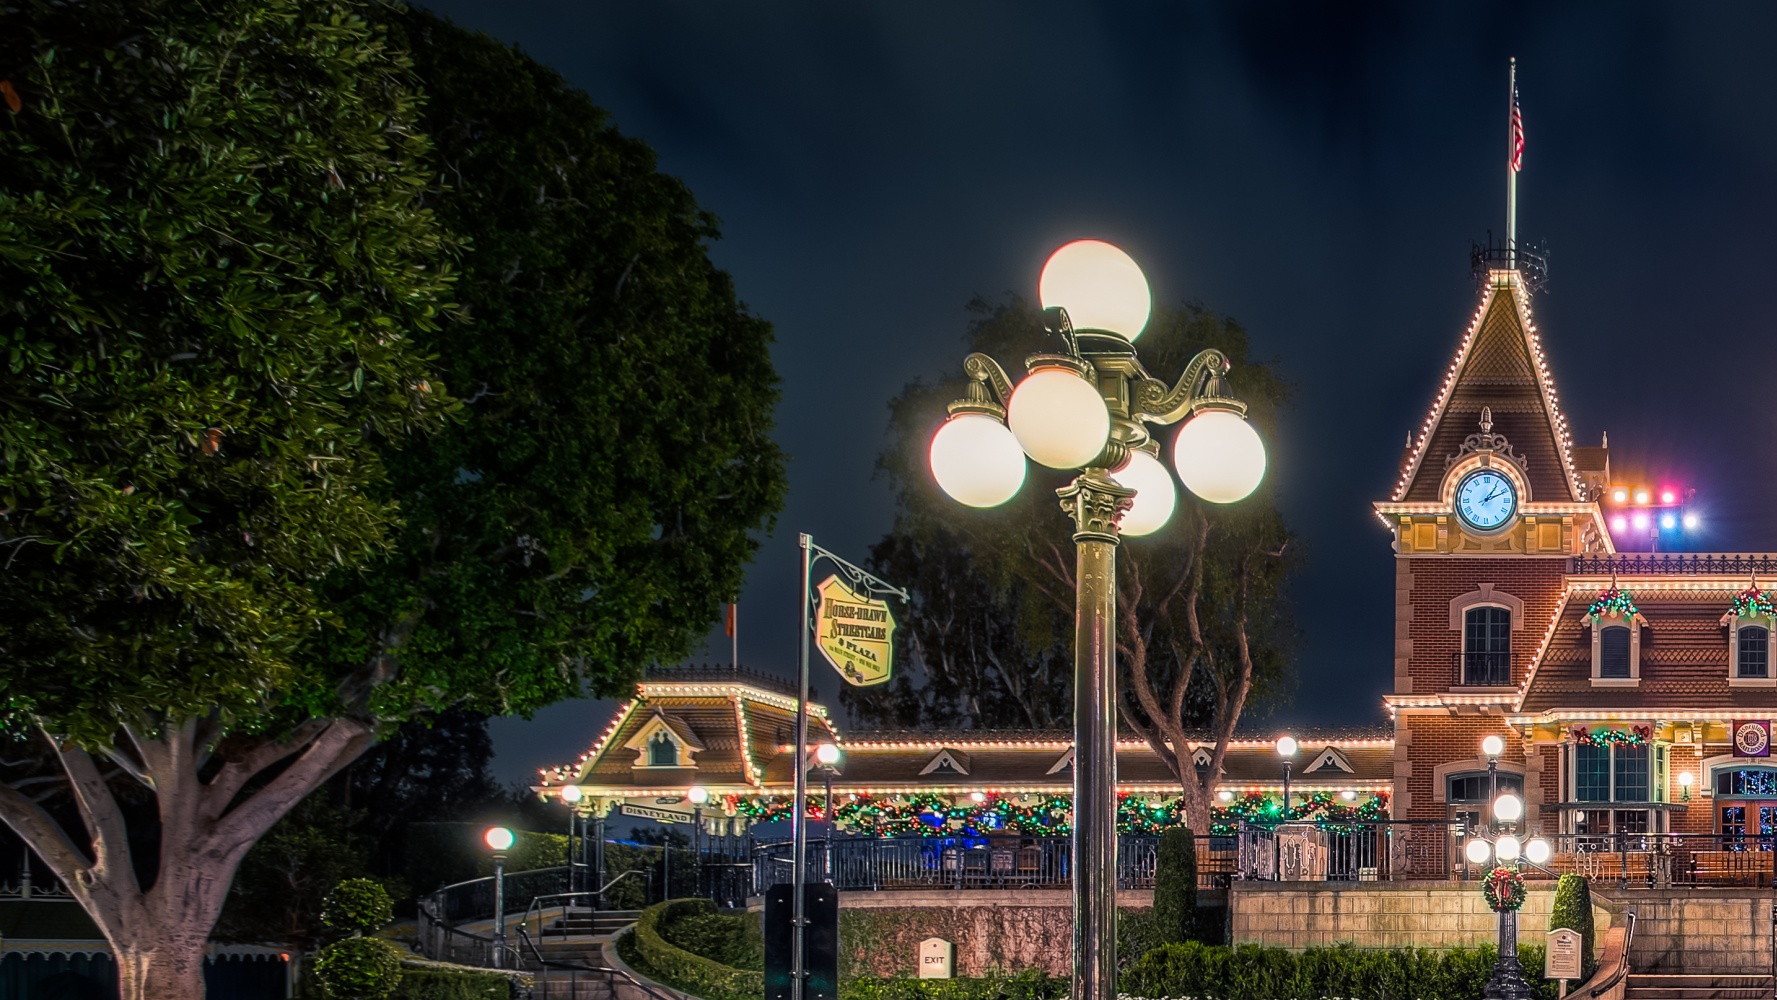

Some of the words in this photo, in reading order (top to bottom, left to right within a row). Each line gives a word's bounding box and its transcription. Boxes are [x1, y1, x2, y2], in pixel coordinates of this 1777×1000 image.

[846, 641, 877, 662] PLAZA
[1738, 742, 1765, 753] RAILROAD
[626, 806, 687, 821] DISNEYLAND
[924, 956, 945, 964] EXIT
